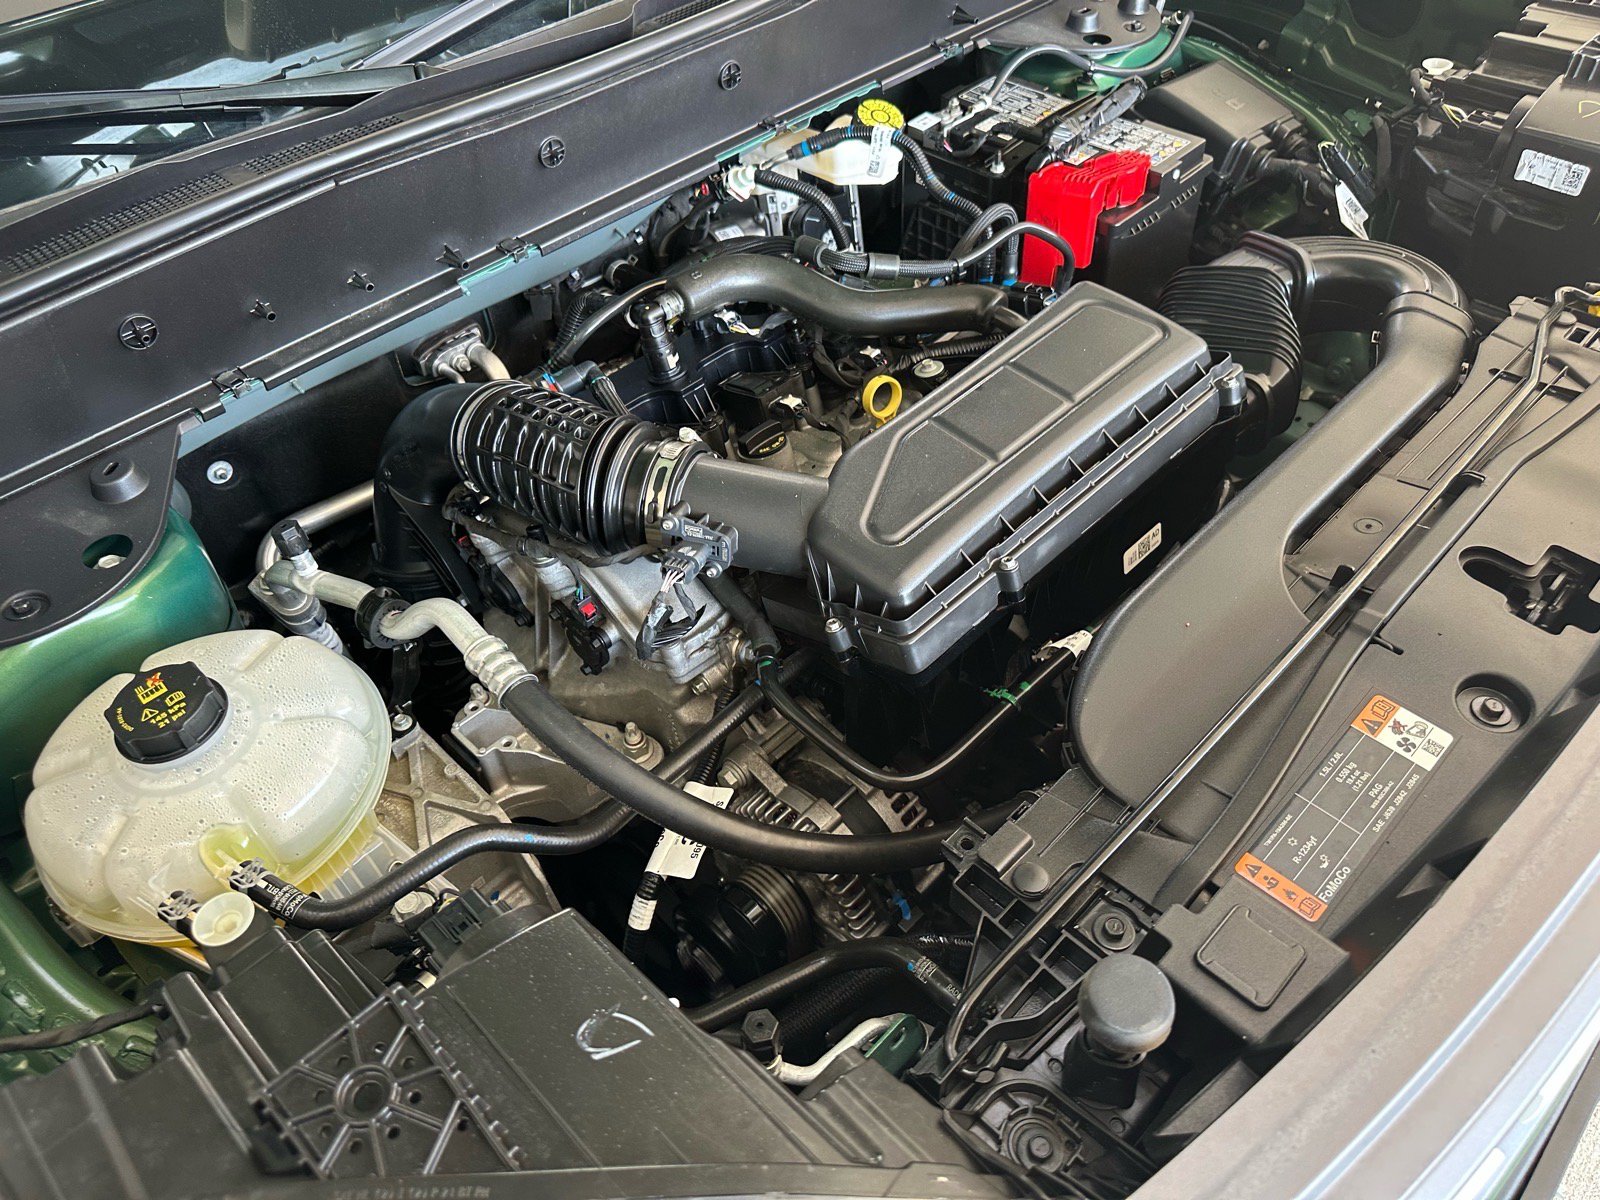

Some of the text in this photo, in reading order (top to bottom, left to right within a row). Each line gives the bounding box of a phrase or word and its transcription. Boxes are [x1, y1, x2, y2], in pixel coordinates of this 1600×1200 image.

[150, 702, 186, 723] 145 kPa
[158, 709, 186, 728] 21 psi
[1346, 761, 1357, 771] kg
[1369, 783, 1383, 797] PAG
[1372, 819, 1385, 832] SAE
[1382, 805, 1395, 819] J639
[1292, 835, 1318, 864] R-1234yf
[1318, 866, 1351, 902] FoMoCo
